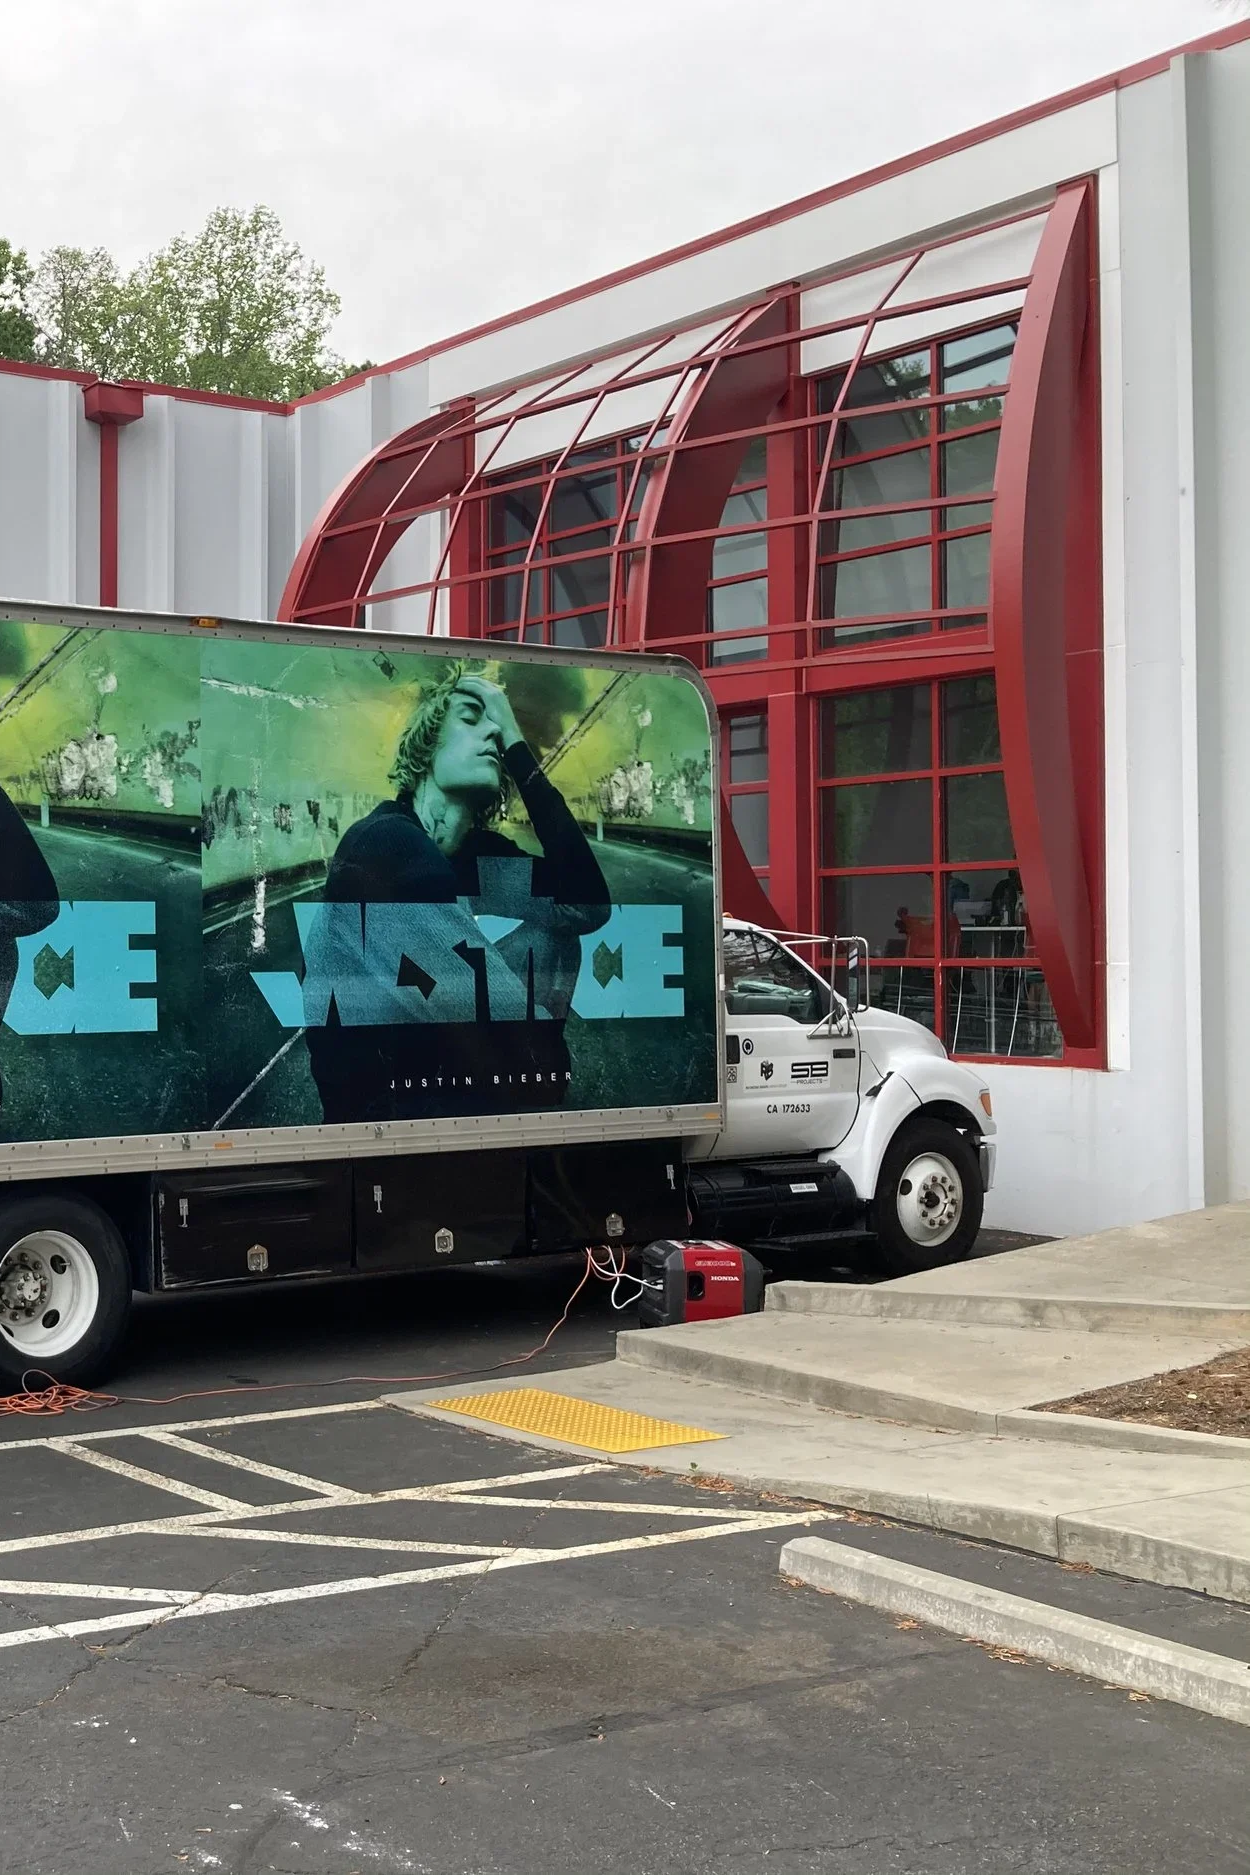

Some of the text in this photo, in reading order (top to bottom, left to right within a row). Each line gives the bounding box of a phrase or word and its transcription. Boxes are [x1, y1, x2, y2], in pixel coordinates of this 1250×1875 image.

[250, 856, 685, 1028] JUSTICE
[390, 1071, 572, 1089] JUSTIN BIEBER
[766, 1103, 811, 1114] CA 172633
